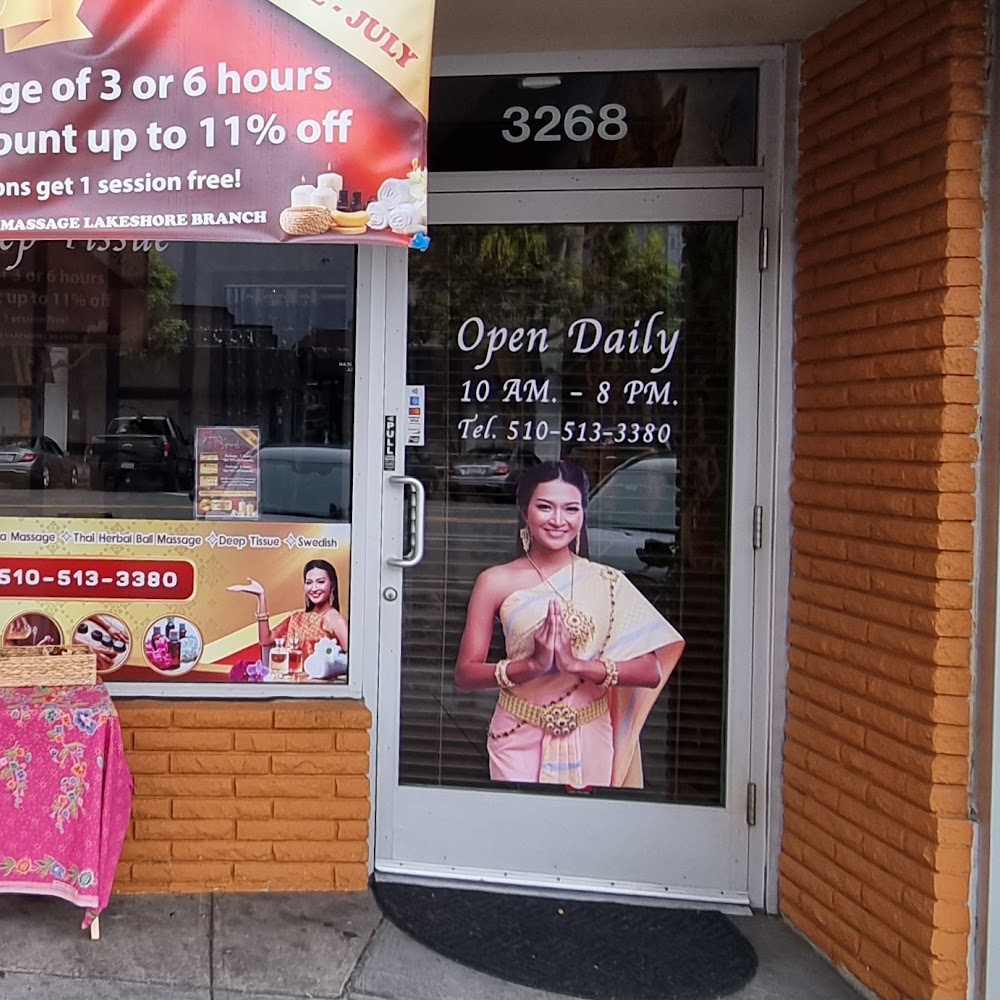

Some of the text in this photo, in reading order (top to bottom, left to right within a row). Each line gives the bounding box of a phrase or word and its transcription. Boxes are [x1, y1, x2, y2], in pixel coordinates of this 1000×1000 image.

[345, 10, 418, 68] JULY
[51, 67, 92, 102] of
[100, 69, 122, 101] 3
[132, 73, 174, 100] or
[183, 66, 207, 97] 6
[217, 62, 332, 95] hours
[87, 127, 137, 161] up
[146, 121, 187, 151] to
[199, 113, 286, 147] 11%
[296, 109, 353, 144] off
[502, 104, 628, 143] 3268
[36, 177, 73, 201] get
[81, 176, 90, 194] 1
[98, 172, 181, 193] session
[187, 169, 241, 190] free!
[0, 217, 81, 231] MASSAGE
[83, 213, 188, 229] LAKESHORE
[191, 210, 267, 225] BRANCH
[457, 311, 680, 374] Open Daily
[461, 380, 490, 402] 10
[502, 378, 557, 403] AM.
[597, 381, 610, 404] 8
[623, 380, 679, 406] PM.
[386, 422, 395, 455] PULL
[457, 414, 671, 443] Tel. 510-513-3380
[11, 532, 56, 543] Massage
[74, 533, 94, 543] Thai
[99, 533, 132, 543] Herbal
[136, 534, 154, 544] Ball
[158, 535, 201, 546] Massage
[219, 536, 245, 547] Deep
[251, 536, 280, 546] Tissue
[298, 537, 337, 547] Swedish
